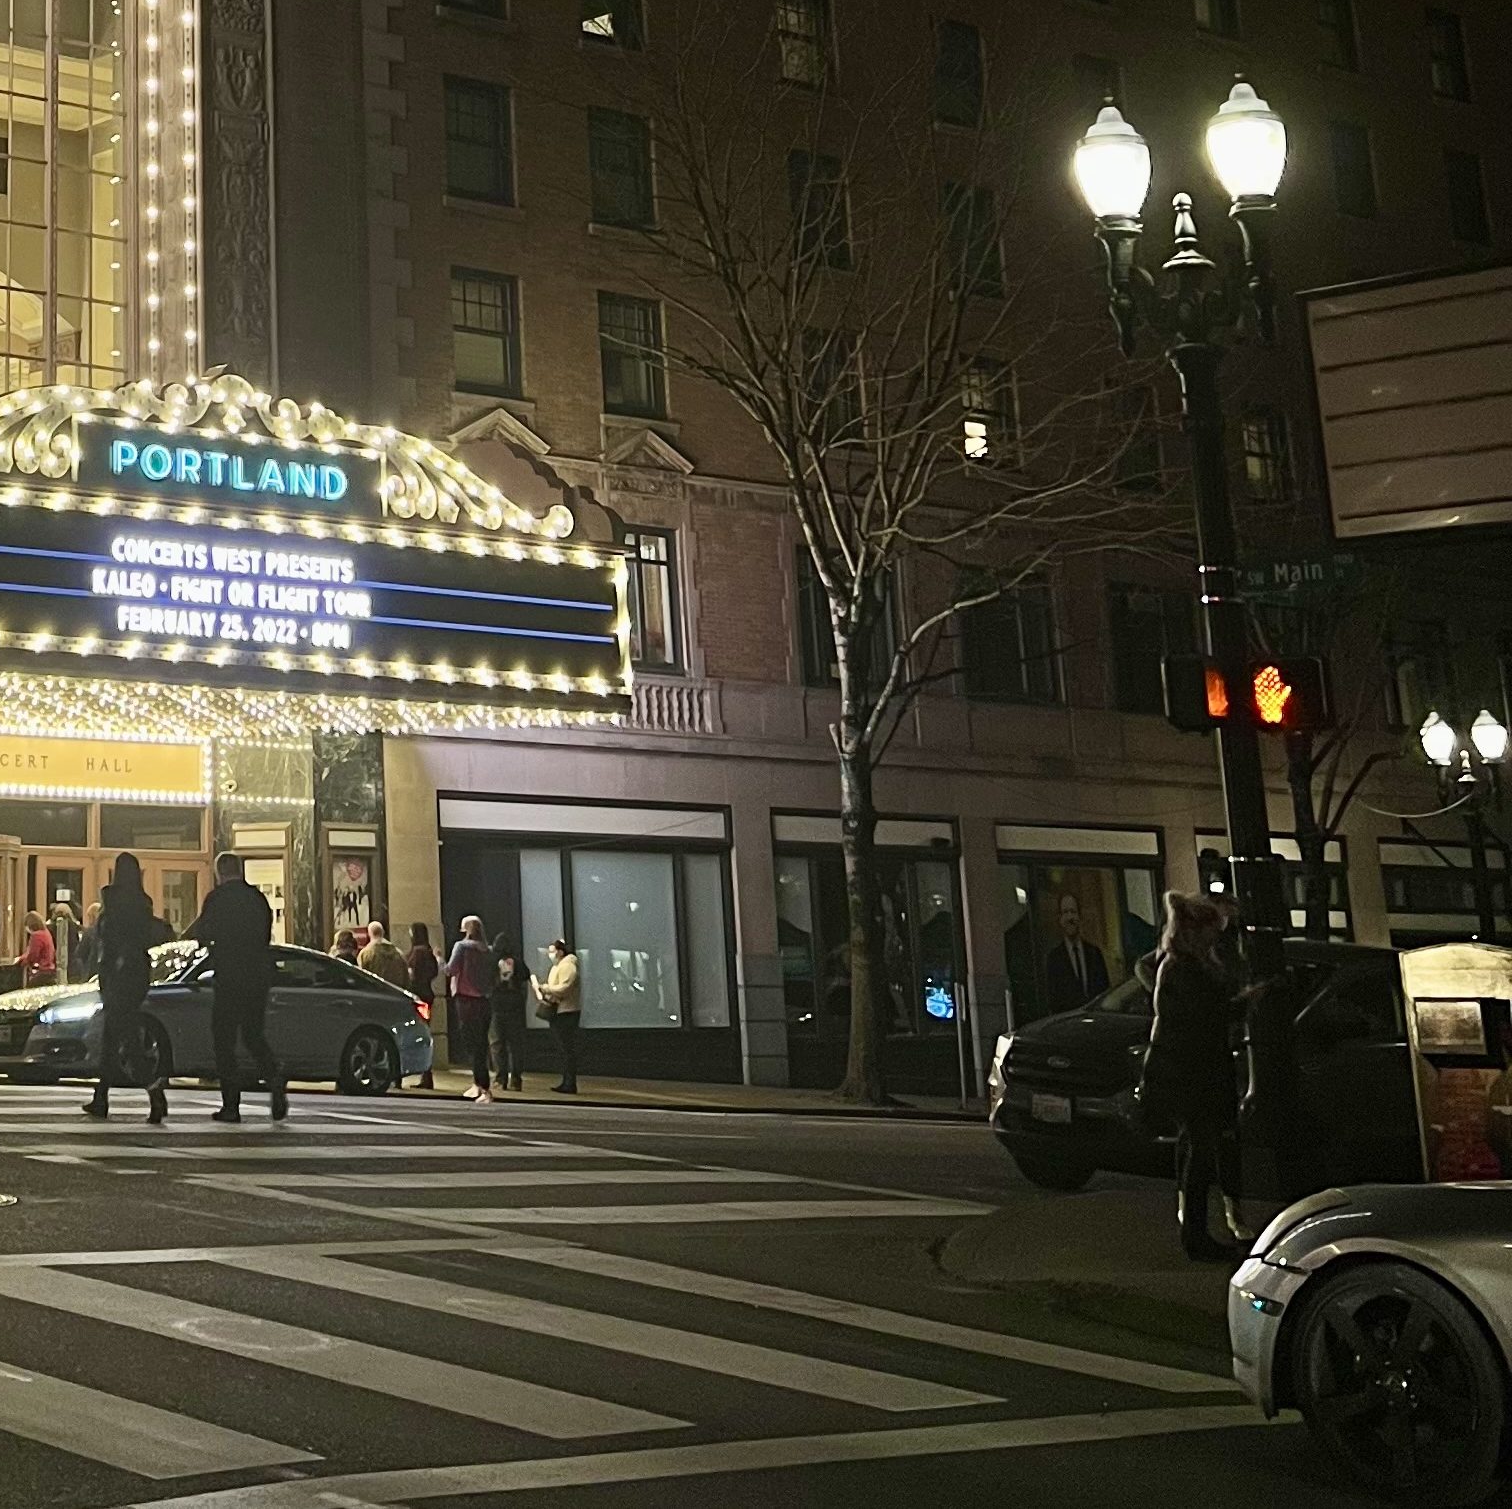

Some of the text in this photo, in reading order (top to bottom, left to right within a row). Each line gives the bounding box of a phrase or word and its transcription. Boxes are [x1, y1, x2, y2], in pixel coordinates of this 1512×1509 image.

[109, 440, 348, 501] PORTLAND
[112, 537, 355, 584] CONCERTS WEST PRESENTS
[1274, 560, 1323, 583] Main
[92, 568, 156, 598] KALEO
[170, 576, 225, 604] FIGHT
[228, 582, 254, 607] OR
[258, 584, 319, 613] FLIGHT
[117, 605, 216, 638] FEBRUARY
[252, 617, 298, 645] 2022
[86, 757, 132, 773] HALL
